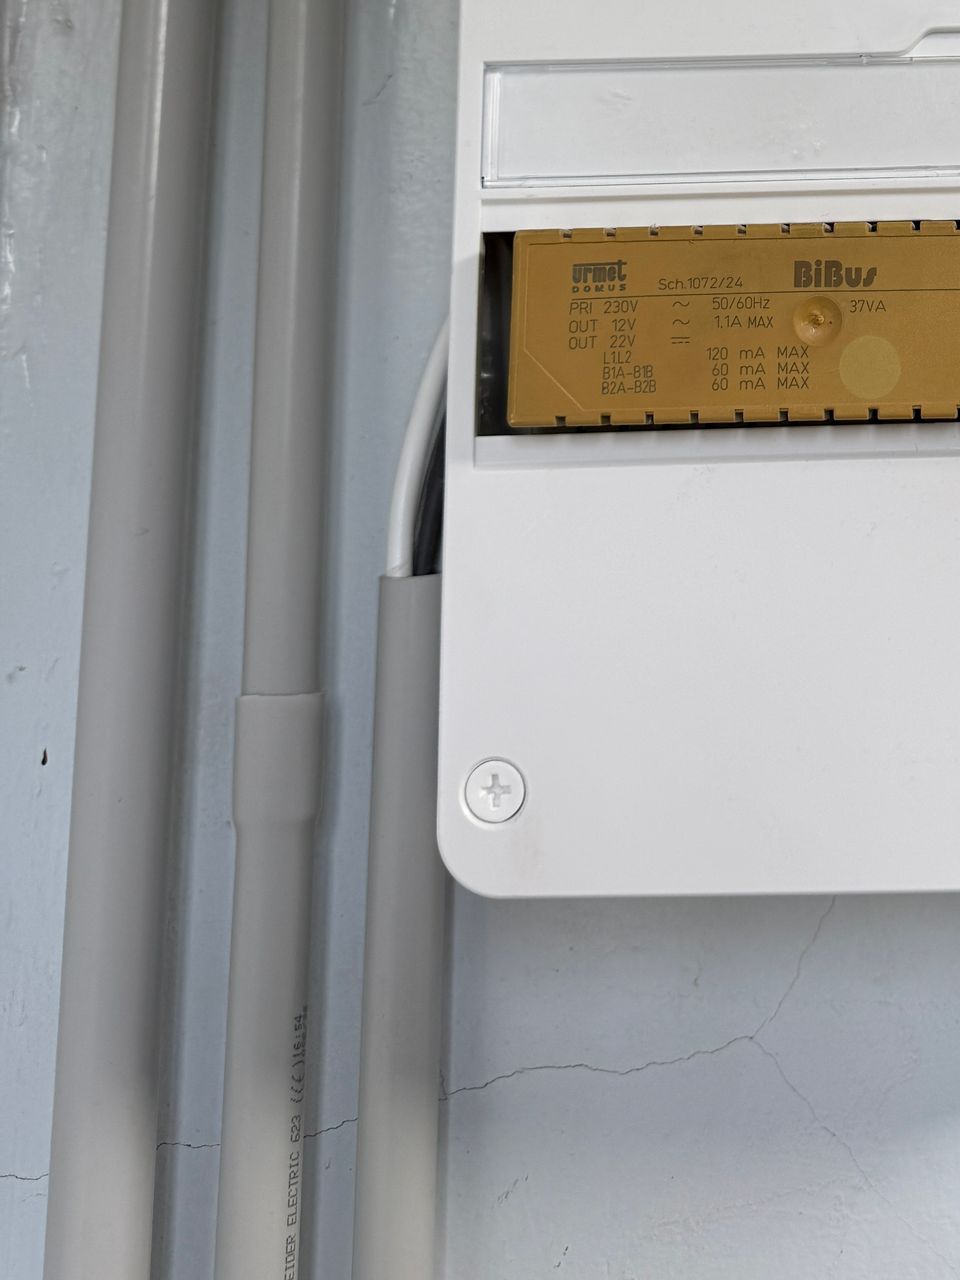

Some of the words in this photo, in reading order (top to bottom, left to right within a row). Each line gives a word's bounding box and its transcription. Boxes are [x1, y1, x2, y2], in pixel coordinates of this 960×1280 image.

[572, 260, 627, 284] urmet
[793, 260, 878, 288] BiBus
[569, 301, 593, 315] PRI
[603, 300, 639, 314] 230V
[712, 297, 770, 310] 50/60Hz
[849, 300, 887, 313] 37VA
[568, 319, 598, 333] OUT
[611, 318, 636, 332] 12V
[714, 315, 742, 329] 1.1A
[747, 316, 774, 328] MAX
[568, 336, 598, 350] OUT
[609, 335, 636, 349] 22V
[706, 346, 729, 360] 120
[739, 346, 766, 360] mA
[777, 345, 809, 359] MAX
[602, 365, 654, 380] B1A-B1B
[711, 363, 729, 376] 60
[739, 362, 766, 375] mA
[777, 362, 809, 375] MAX
[601, 380, 657, 395] B2A-B2B
[711, 378, 729, 391] 60
[739, 377, 766, 390] mA
[777, 376, 809, 390] MAX
[290, 1114, 302, 1143] 623
[287, 1151, 300, 1227] ELECTRIC
